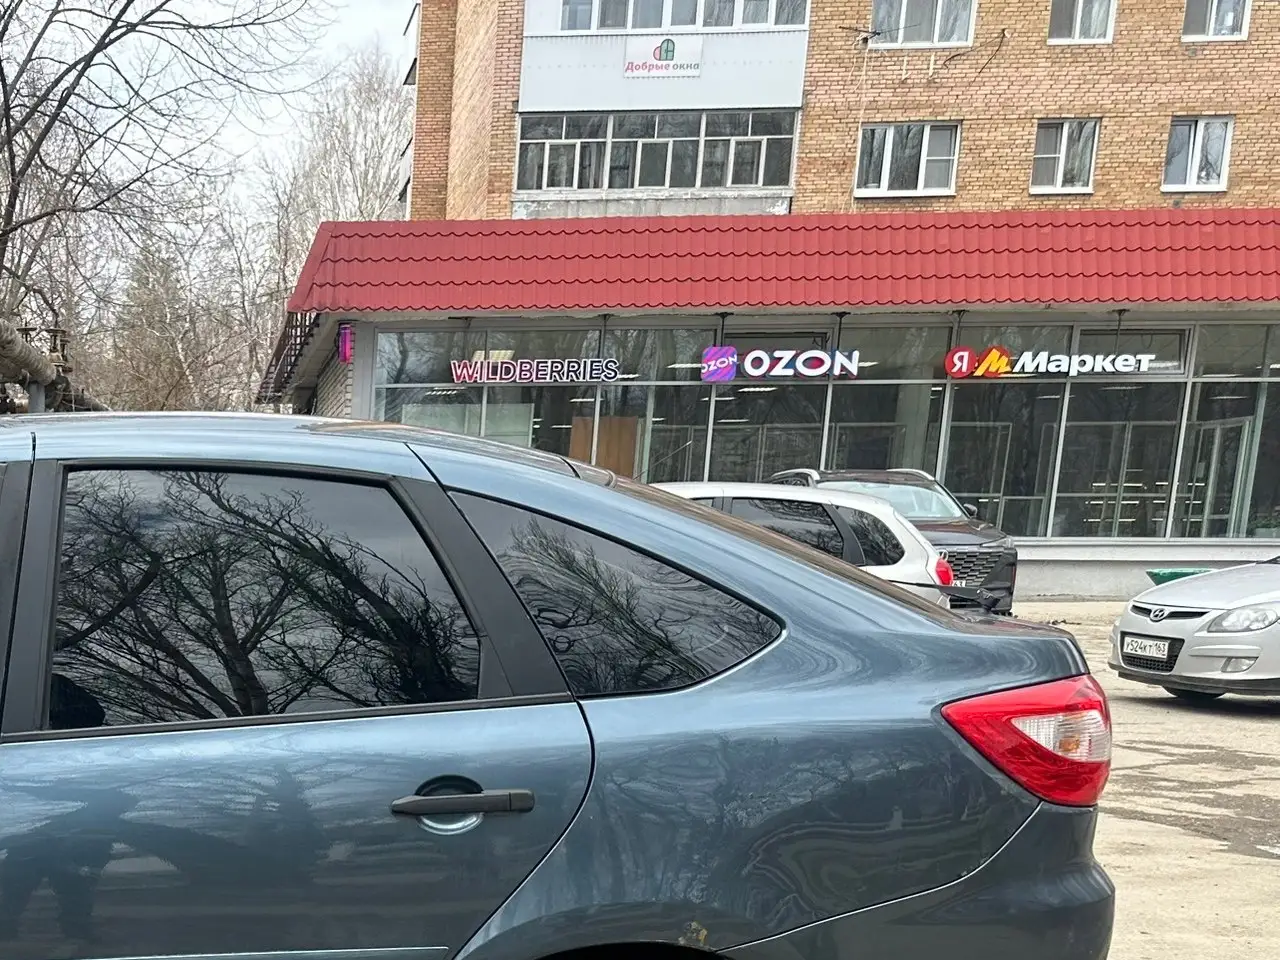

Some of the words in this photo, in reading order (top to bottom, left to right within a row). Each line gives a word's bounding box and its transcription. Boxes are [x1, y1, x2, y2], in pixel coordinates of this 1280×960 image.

[625, 61, 670, 73] Добрые
[672, 62, 699, 71] окна
[451, 359, 620, 383] WILDBERRIES
[743, 349, 860, 378] OZON
[1012, 351, 1156, 376] Маркет
